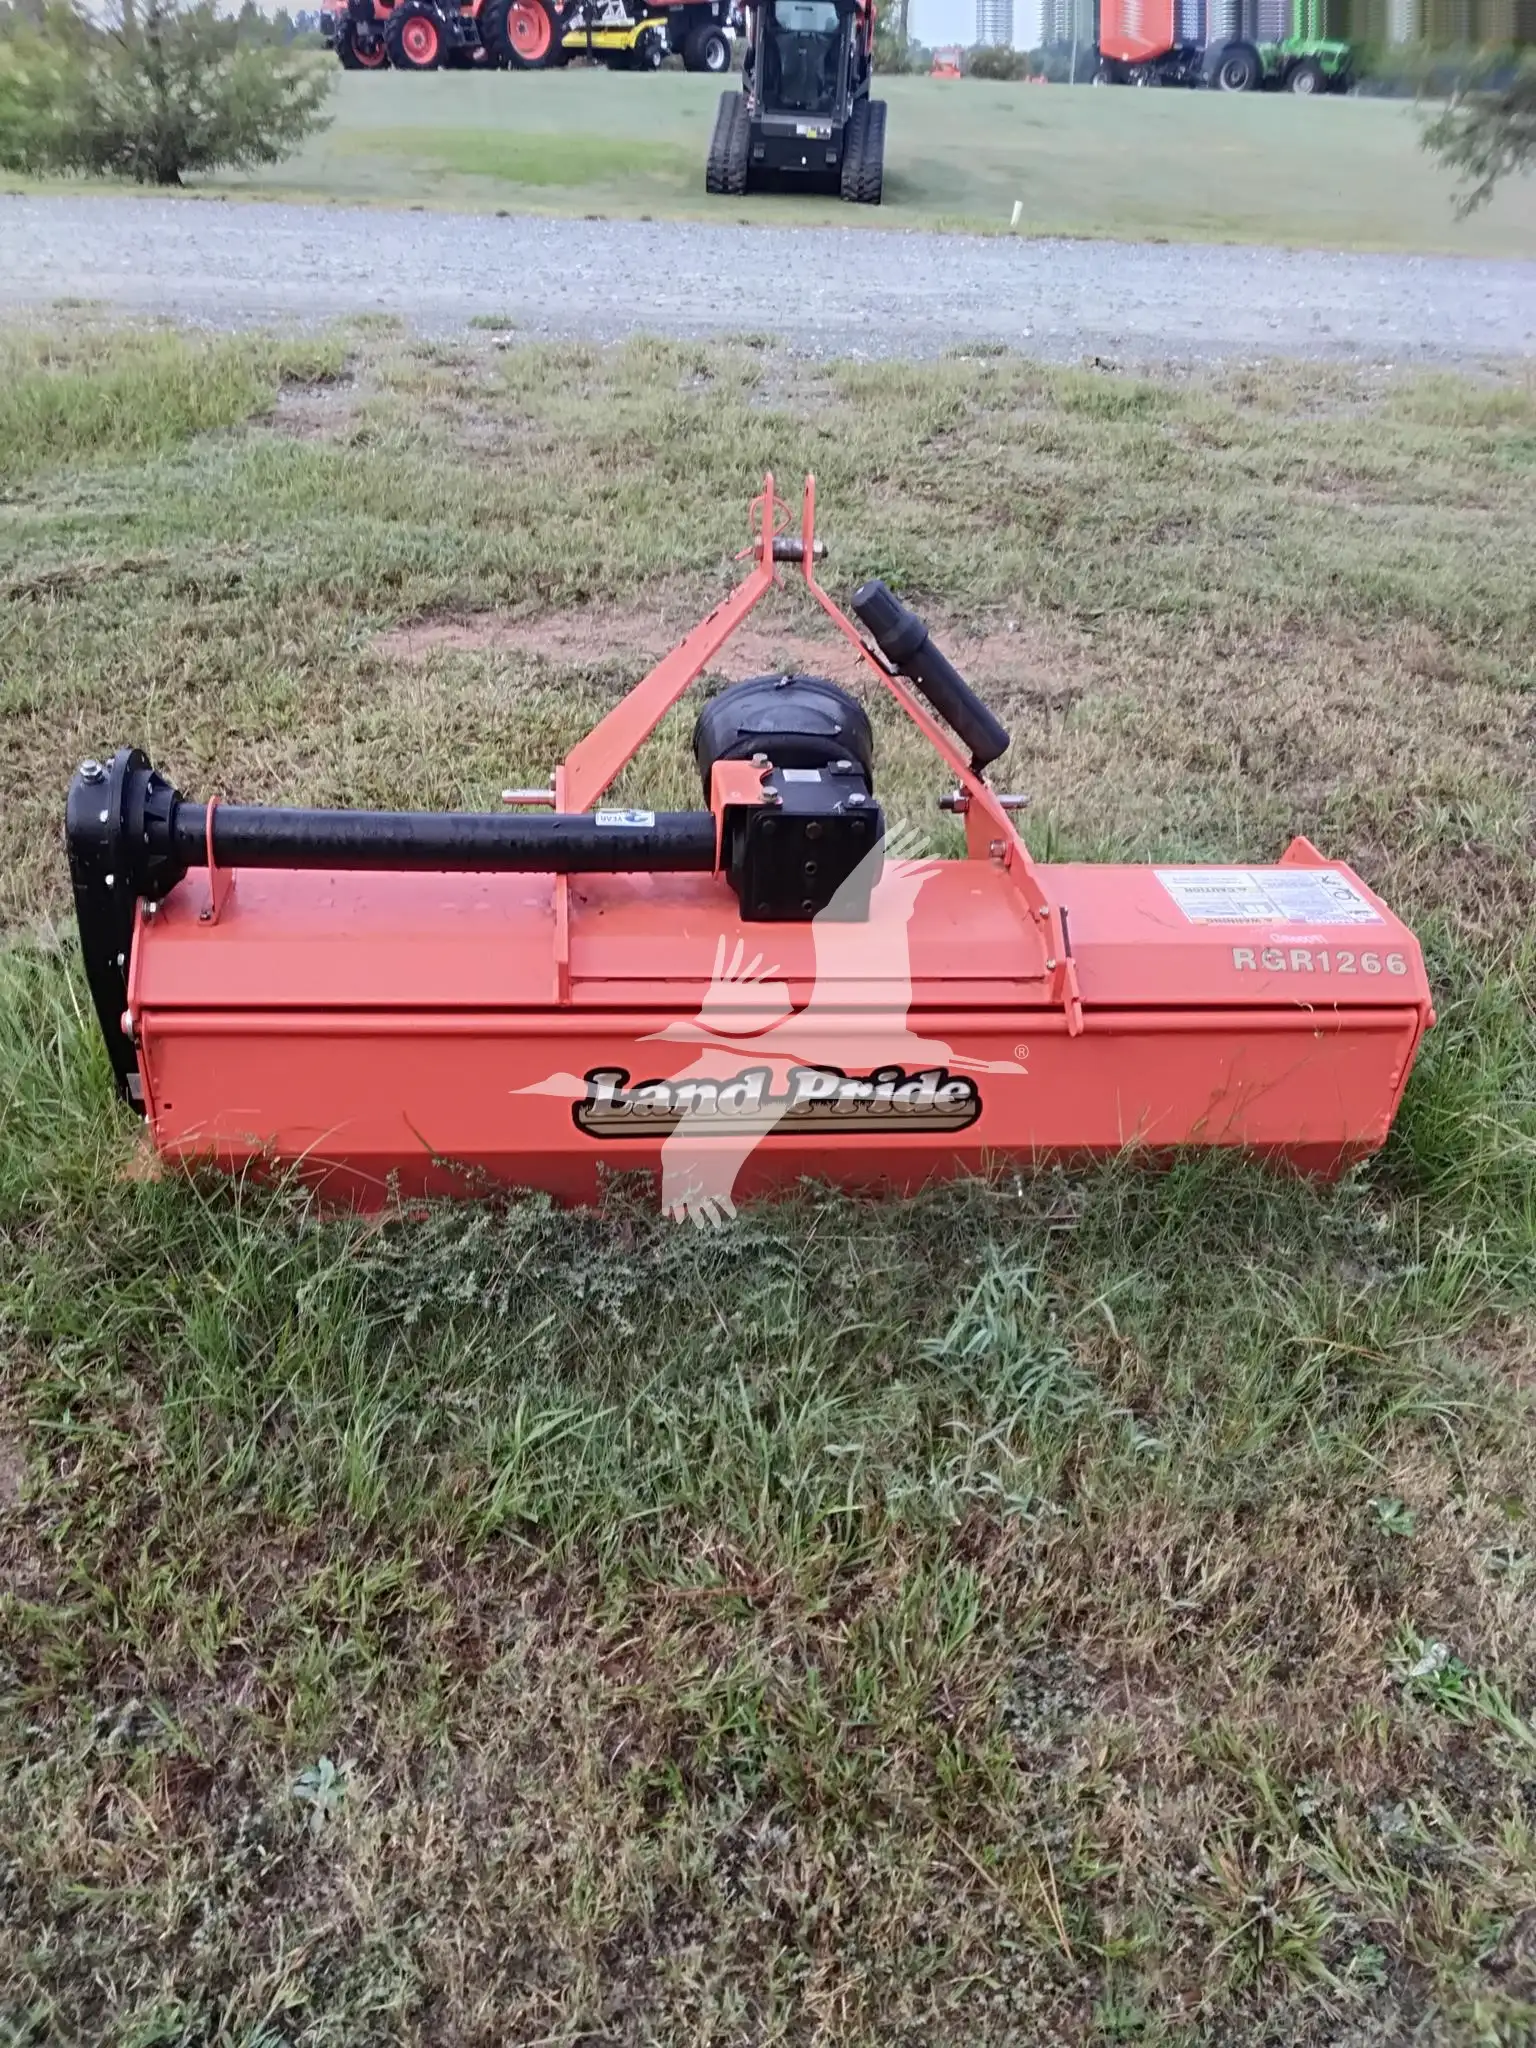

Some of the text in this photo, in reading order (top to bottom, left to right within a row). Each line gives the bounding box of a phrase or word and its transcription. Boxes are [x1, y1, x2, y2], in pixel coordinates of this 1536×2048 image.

[1232, 948, 1407, 975] RGR1266
[587, 1071, 971, 1117] Land Pride
